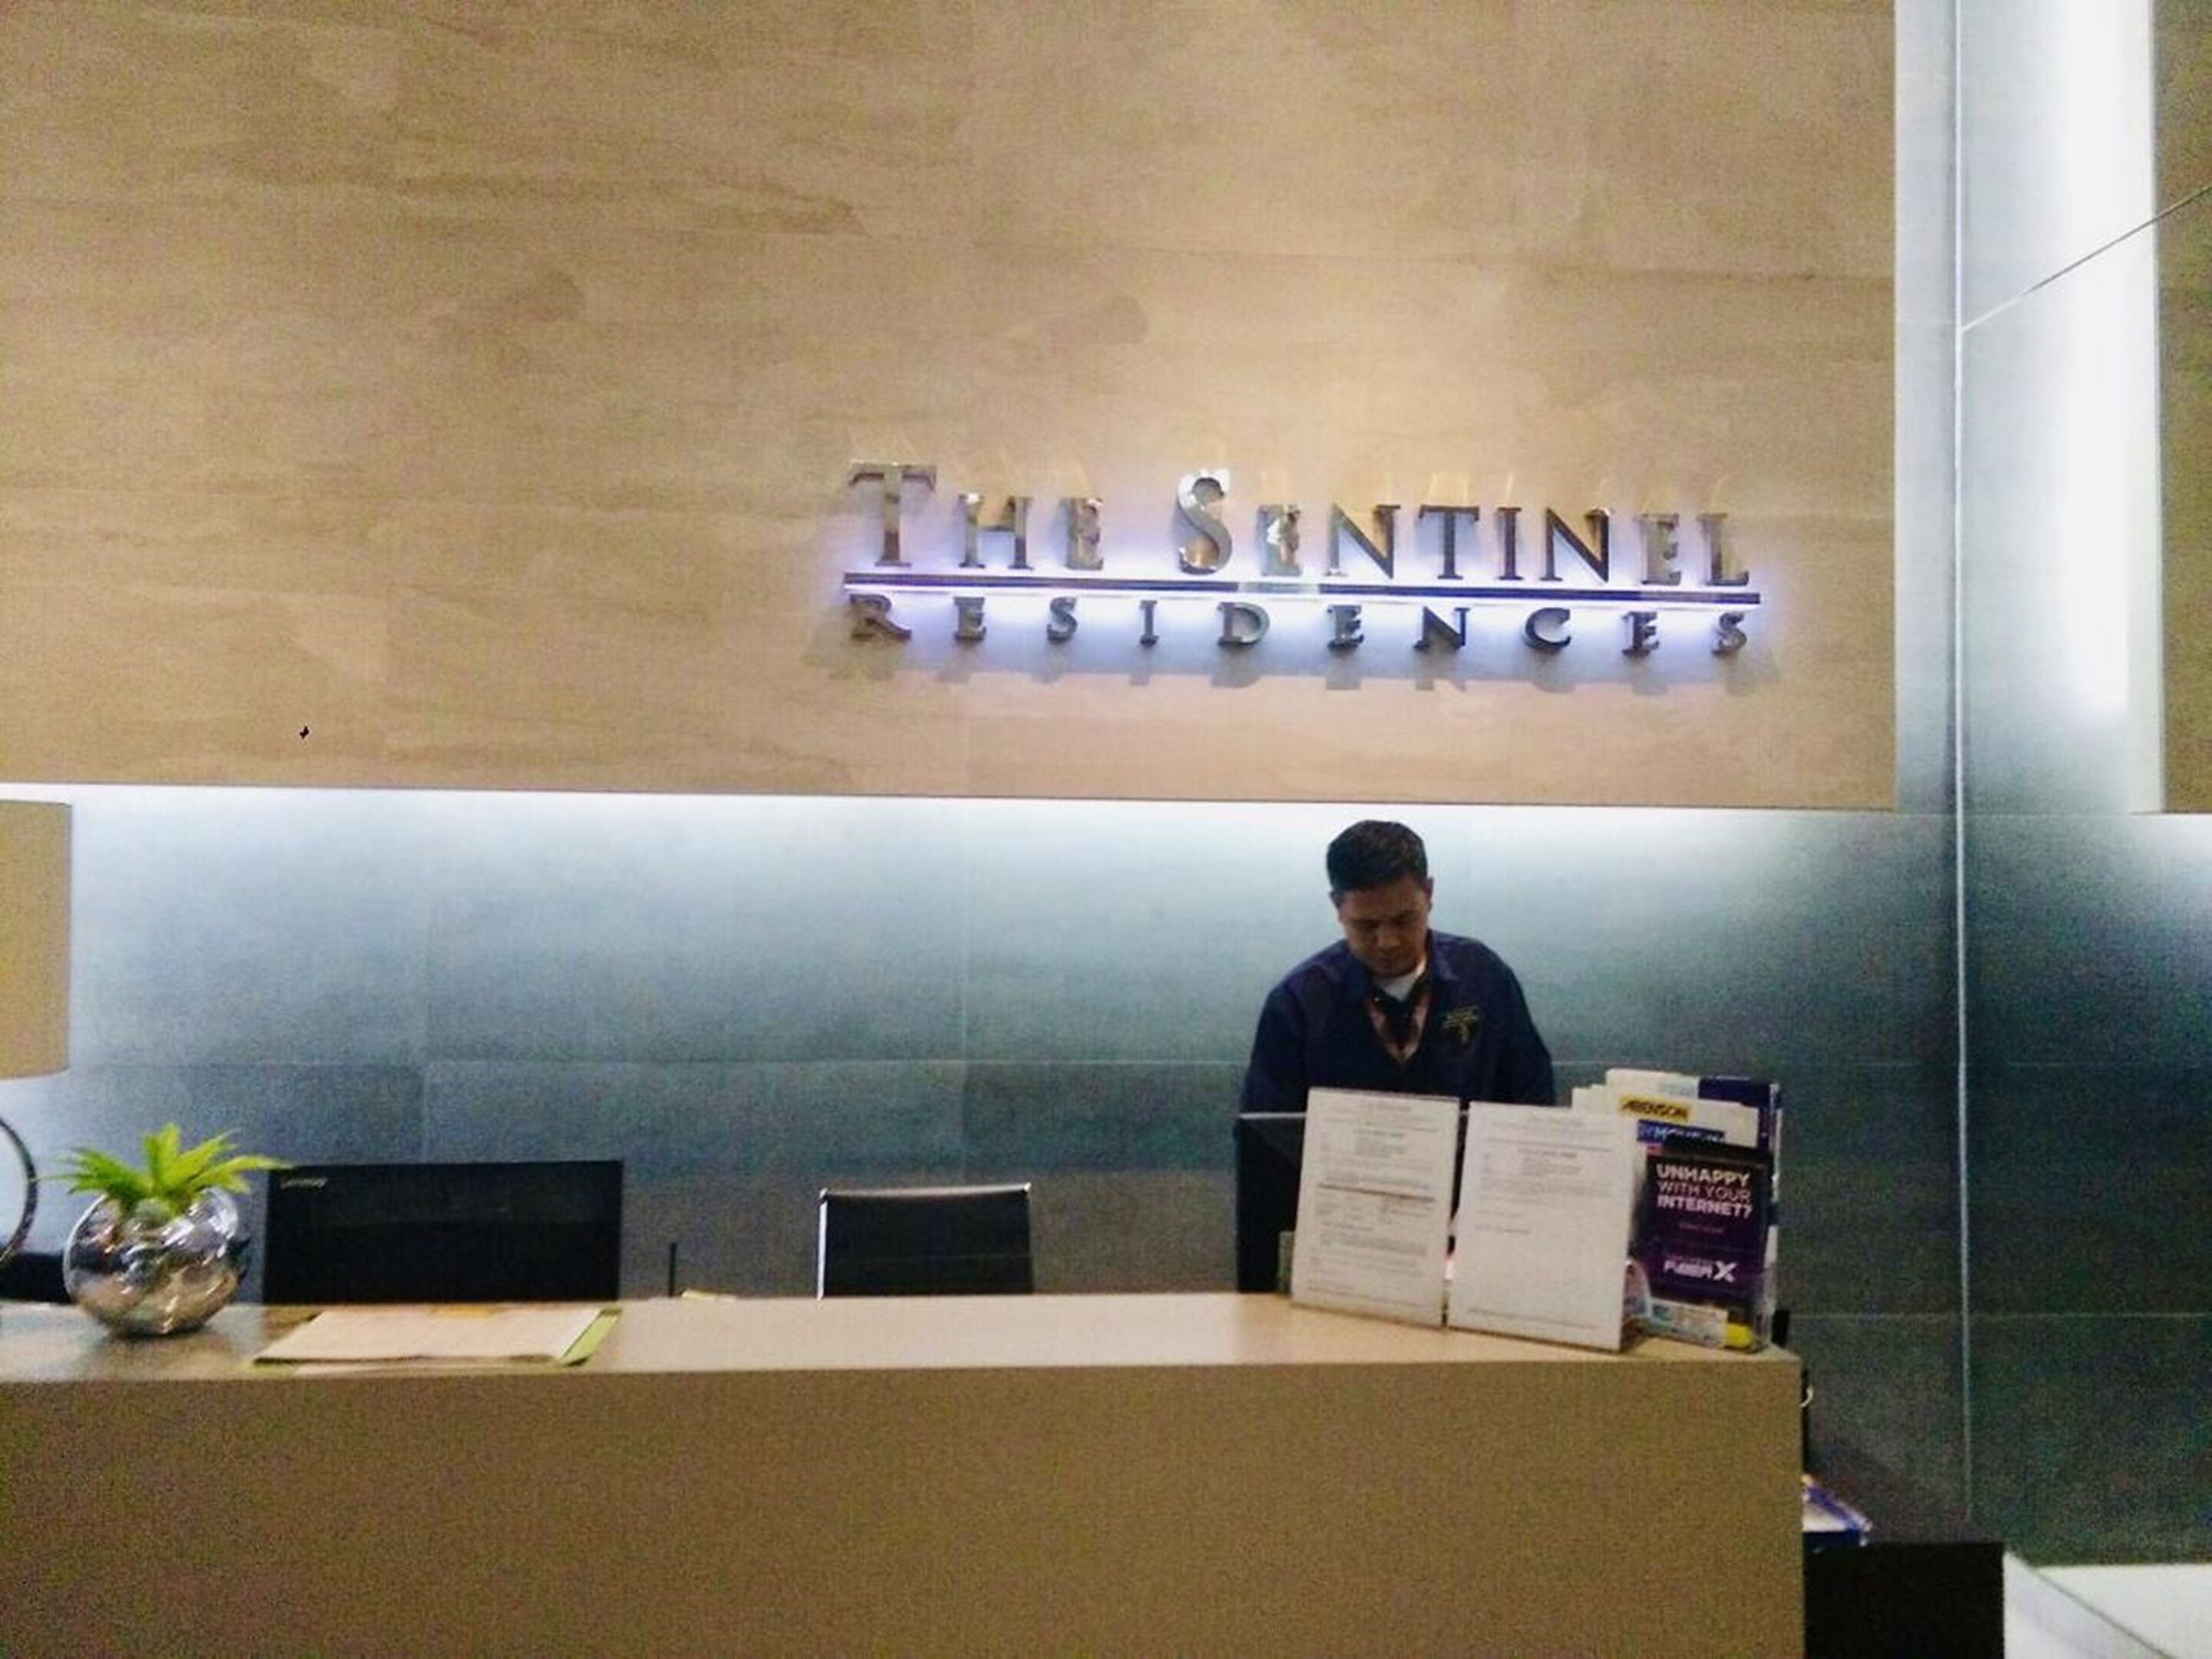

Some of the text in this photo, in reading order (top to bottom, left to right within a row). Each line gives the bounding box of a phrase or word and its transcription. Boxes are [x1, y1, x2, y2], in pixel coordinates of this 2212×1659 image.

[849, 462, 1750, 588] THE SENTINEL
[850, 594, 1748, 655] RESIDENCES
[1657, 1164, 1750, 1187] UNHAPPY
[1657, 1181, 1751, 1204] WITH YOUR
[1657, 1194, 1753, 1219] INTERNET?
